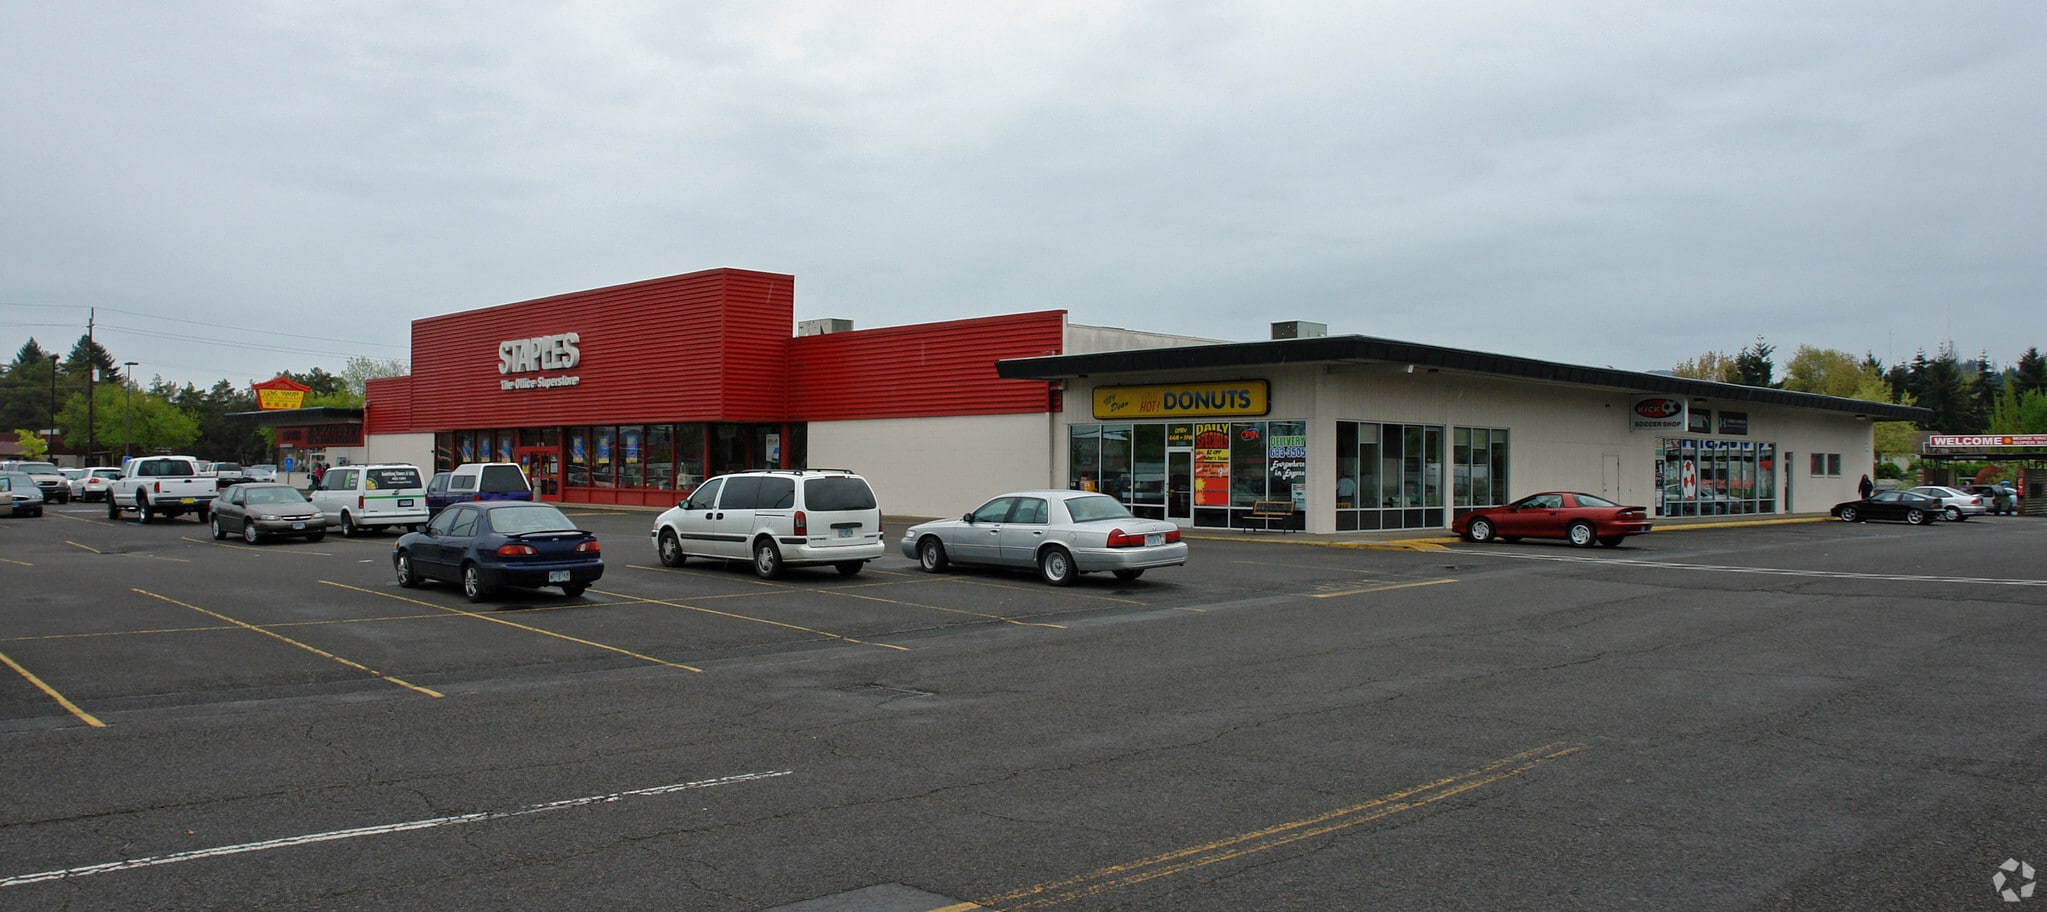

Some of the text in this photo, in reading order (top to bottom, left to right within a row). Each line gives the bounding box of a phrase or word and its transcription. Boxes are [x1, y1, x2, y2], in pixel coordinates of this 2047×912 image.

[498, 332, 580, 374] STAPLES
[501, 375, 580, 390] The Office Superstore
[1163, 389, 1251, 411] DONUTS
[1195, 423, 1229, 436] DAILY
[1270, 435, 1306, 447] DELIVERY
[1934, 437, 2003, 445] WELCOME
